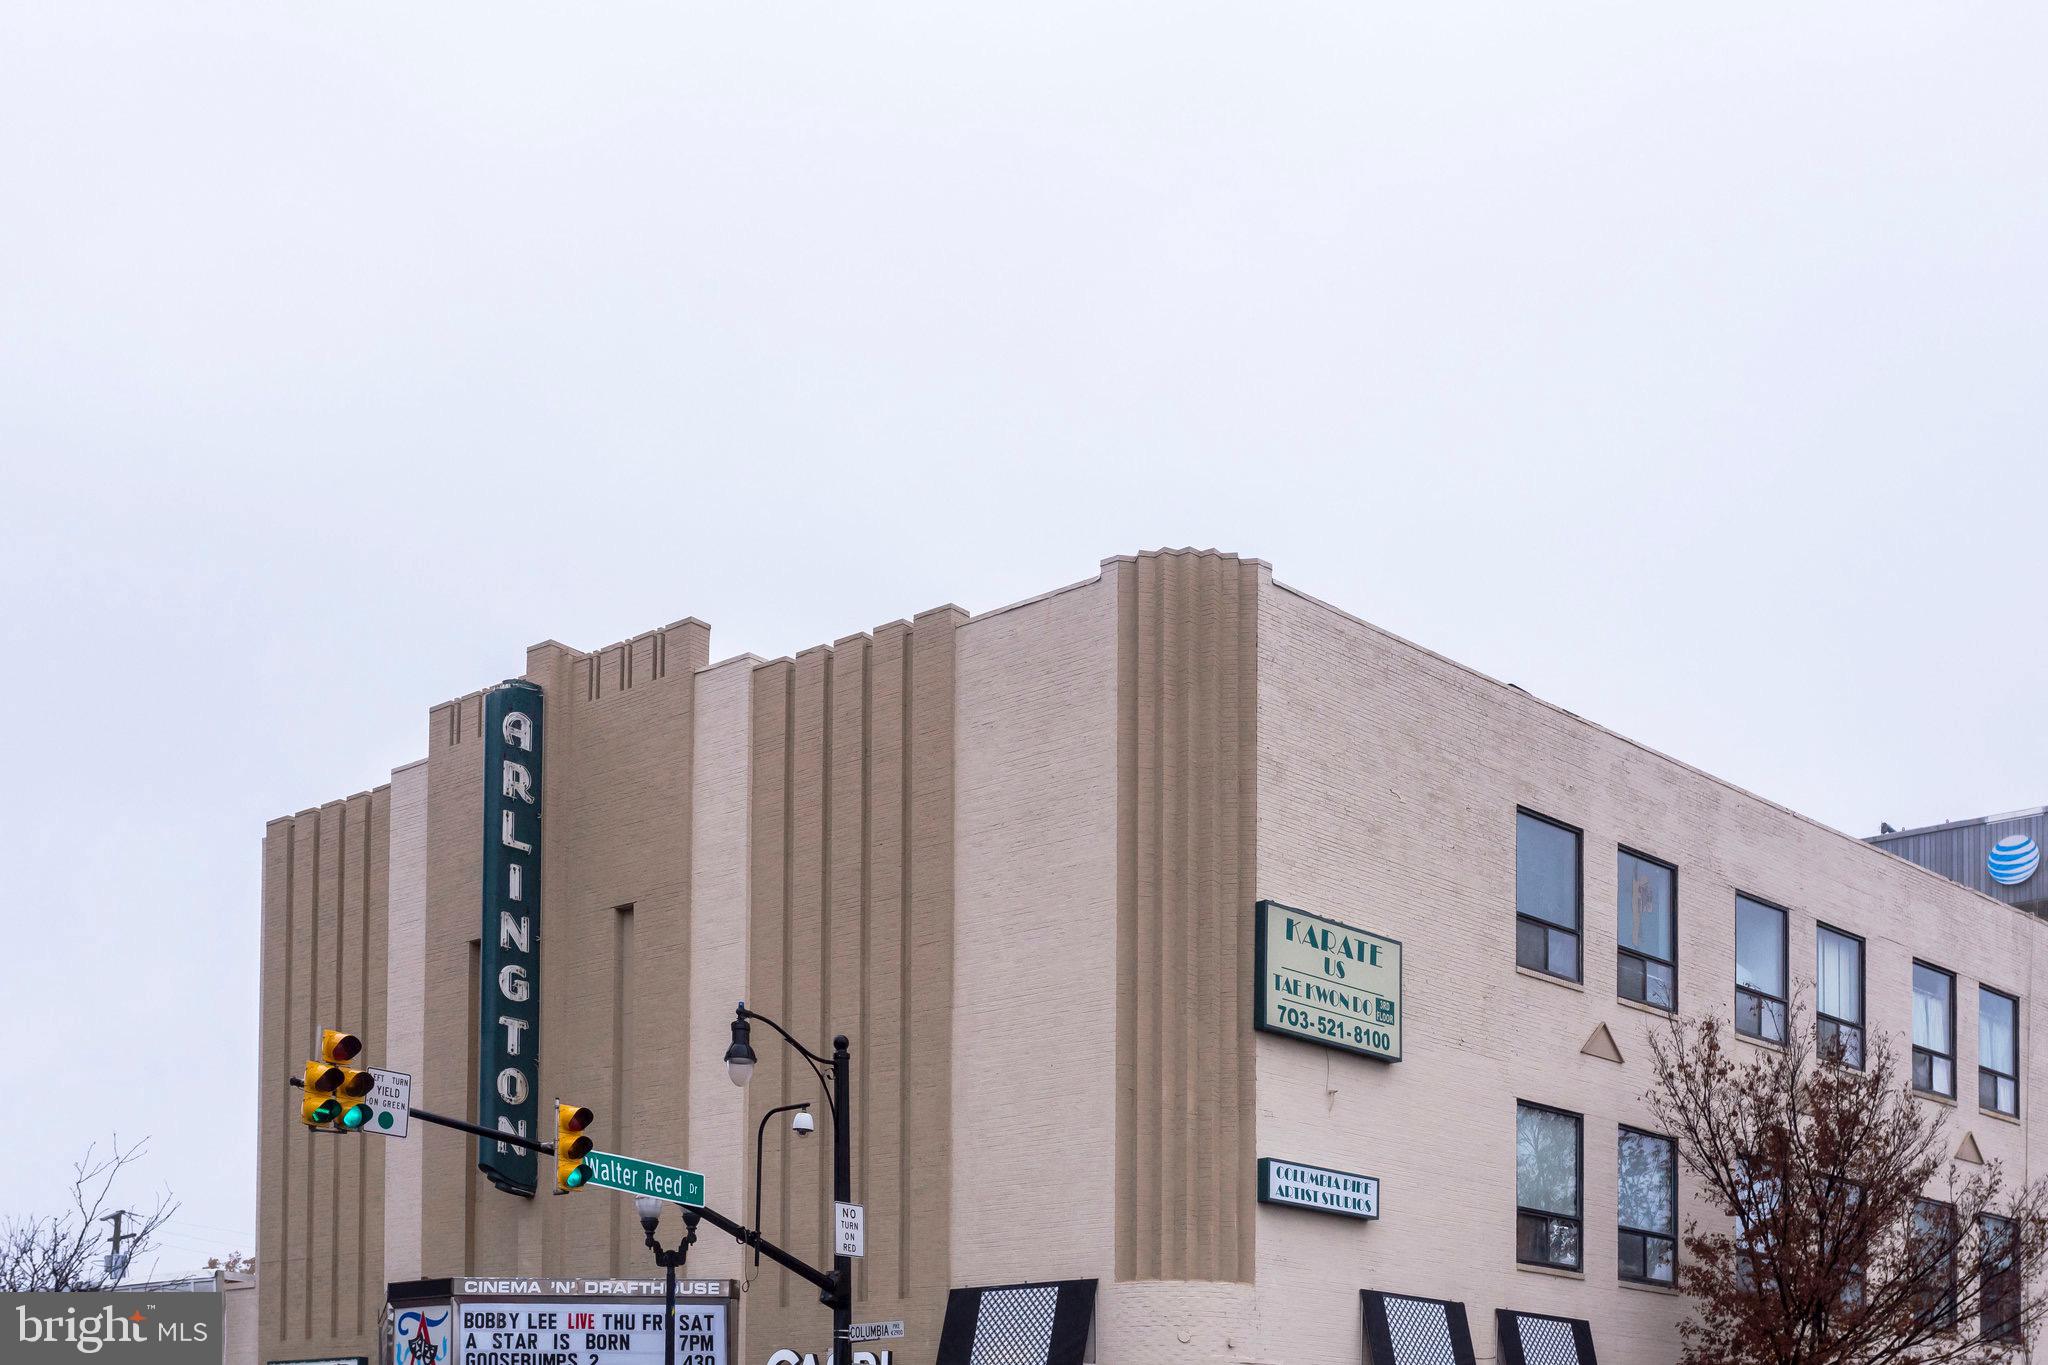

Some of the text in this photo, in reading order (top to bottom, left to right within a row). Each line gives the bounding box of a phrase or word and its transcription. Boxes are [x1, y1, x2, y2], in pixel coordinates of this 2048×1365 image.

[498, 711, 535, 1157] ARLINGTON
[1286, 917, 1383, 968] KARATE
[1324, 956, 1346, 979] US
[1273, 973, 1373, 1016] TAE KWON DO
[1376, 1010, 1394, 1025] FLOOR
[373, 1073, 409, 1087] EFT TURN
[377, 1085, 400, 1099] YIELD
[368, 1097, 406, 1111] ON GREEN
[585, 1156, 698, 1197] Walter Reed Dr
[1276, 1165, 1372, 1196] COLUMBIA PIKE
[1276, 1184, 1372, 1213] ARTIST STUDIOS
[842, 1207, 857, 1219] NO
[841, 1220, 859, 1231] TURN
[844, 1232, 855, 1241] ON
[843, 1243, 857, 1253] RED
[464, 1281, 541, 1294] CINEMA
[584, 1282, 720, 1295] DRAFTHUSE
[464, 1312, 714, 1331] BOBBY LEE LIVE THU FR SAT
[850, 1324, 889, 1339] COLUMBIA
[465, 1333, 714, 1351] A STAR IS BORN 7PM
[589, 1354, 599, 1365] 2
